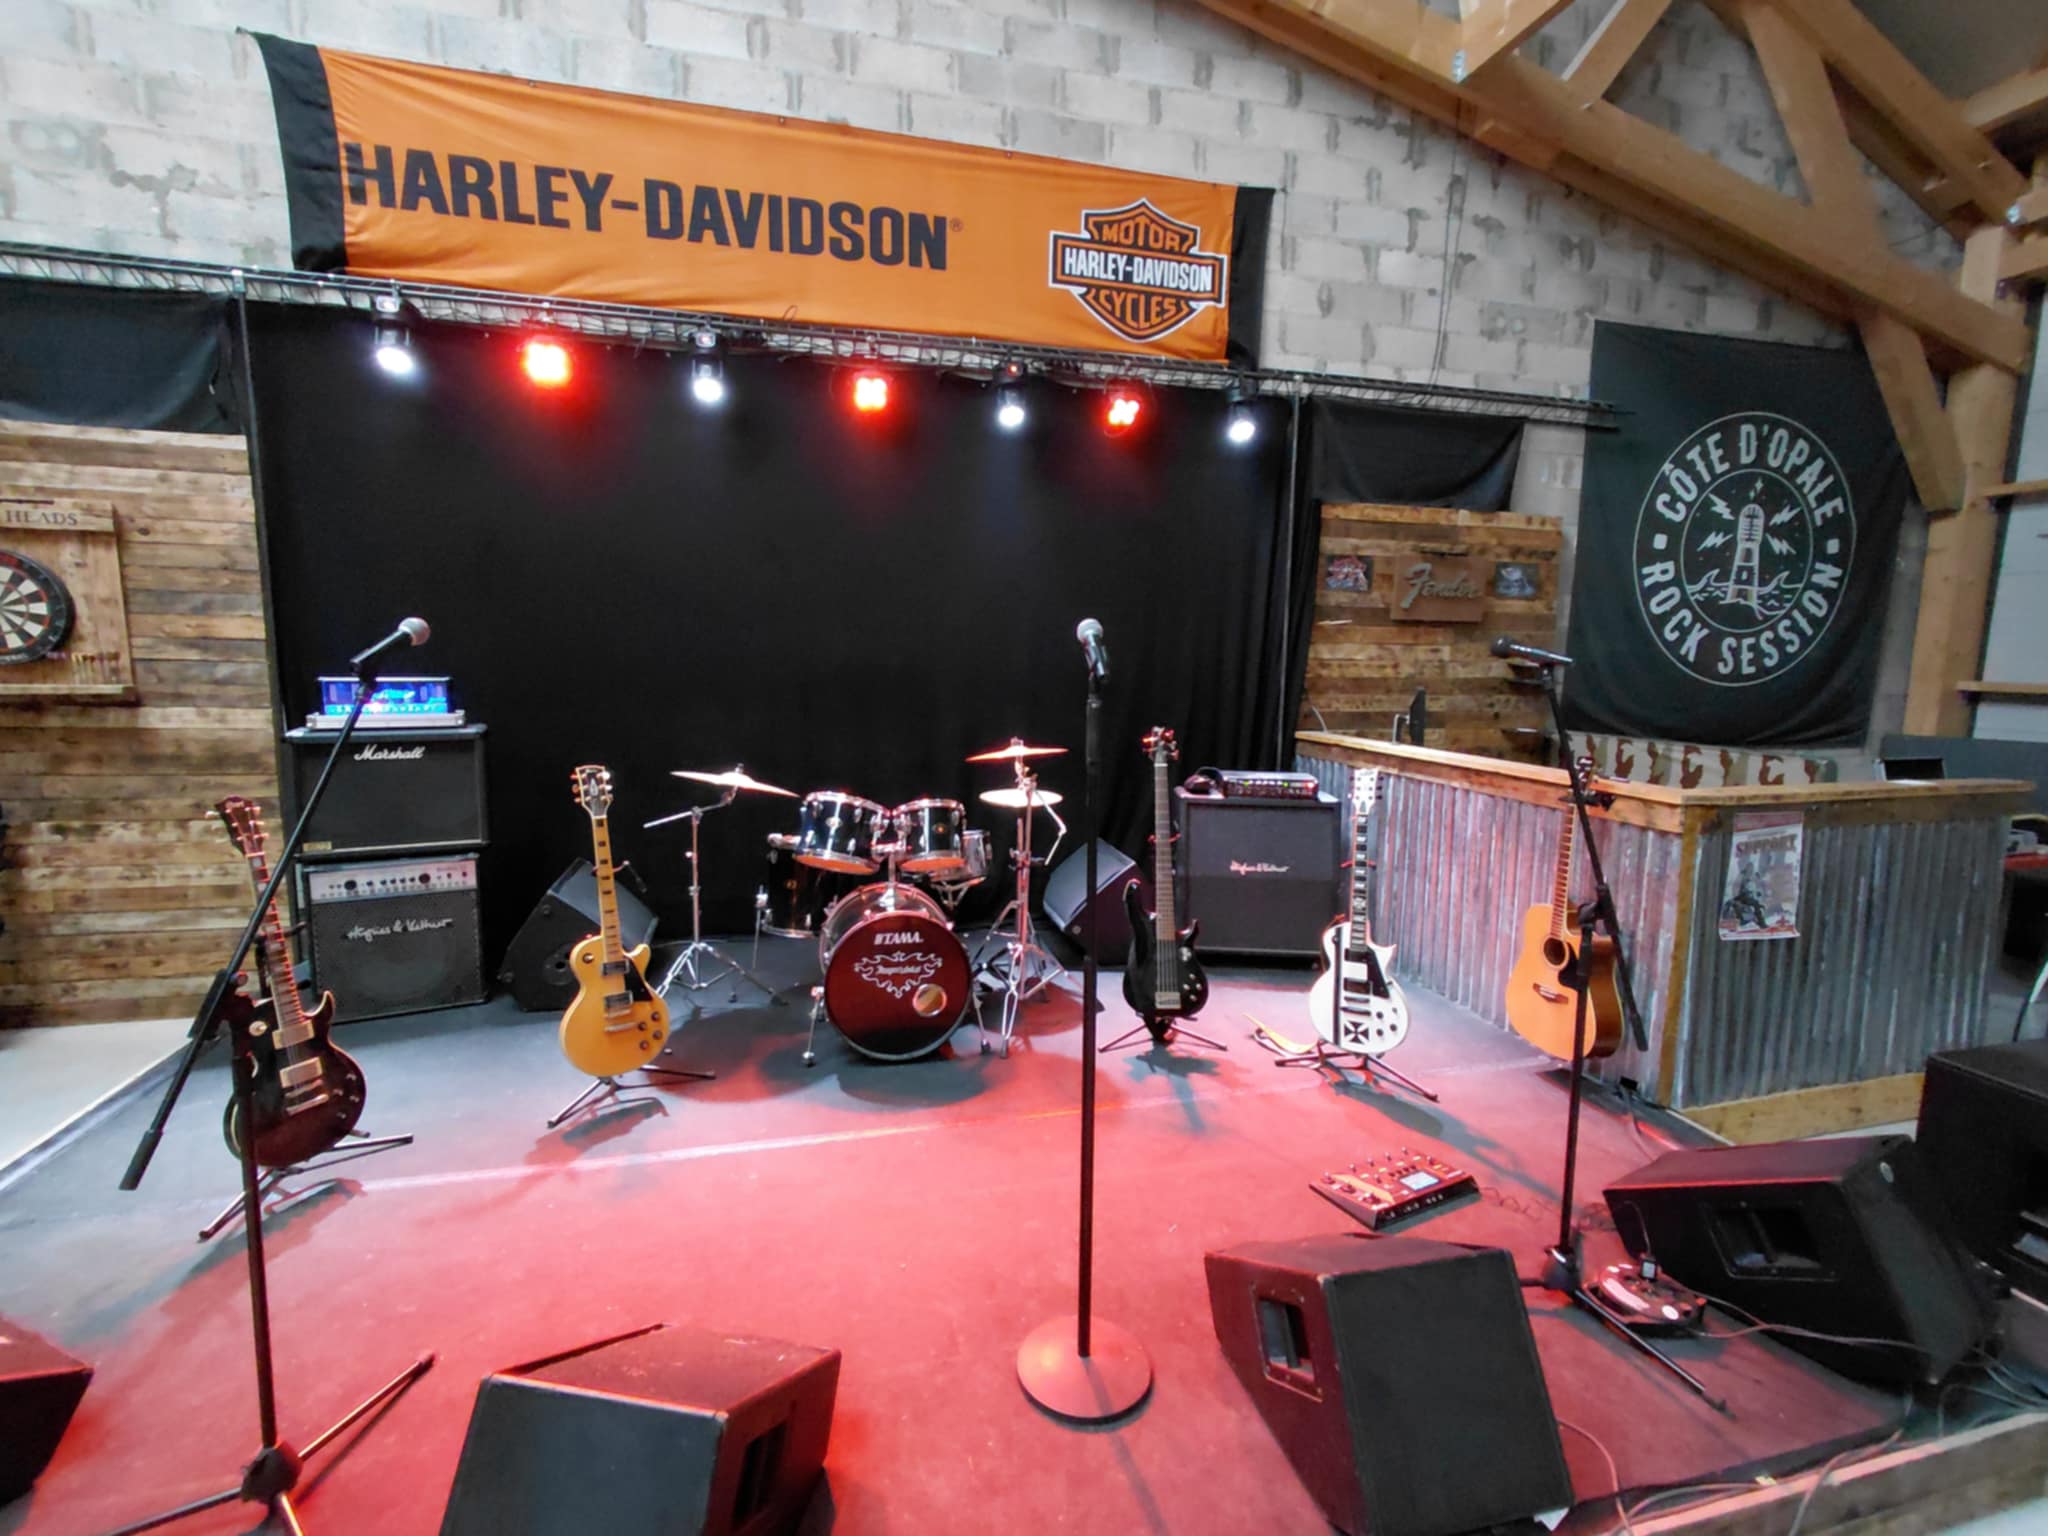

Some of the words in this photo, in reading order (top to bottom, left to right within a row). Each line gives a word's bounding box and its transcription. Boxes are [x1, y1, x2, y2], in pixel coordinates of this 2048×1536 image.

[343, 142, 947, 271] HARLEY-DAVIDSON
[1102, 215, 1181, 251] MOTOR
[1064, 247, 1213, 292] HARLEY-DAVIDSON
[1099, 288, 1177, 329] CYCLES
[1655, 432, 1730, 522] CÔTE
[1740, 423, 1845, 527] D'OPALE
[5, 509, 79, 526] HEADS
[1401, 562, 1483, 608] Fender
[1641, 560, 1710, 663] ROCK
[1717, 561, 1843, 675] SESSION
[354, 744, 426, 760] Marshall
